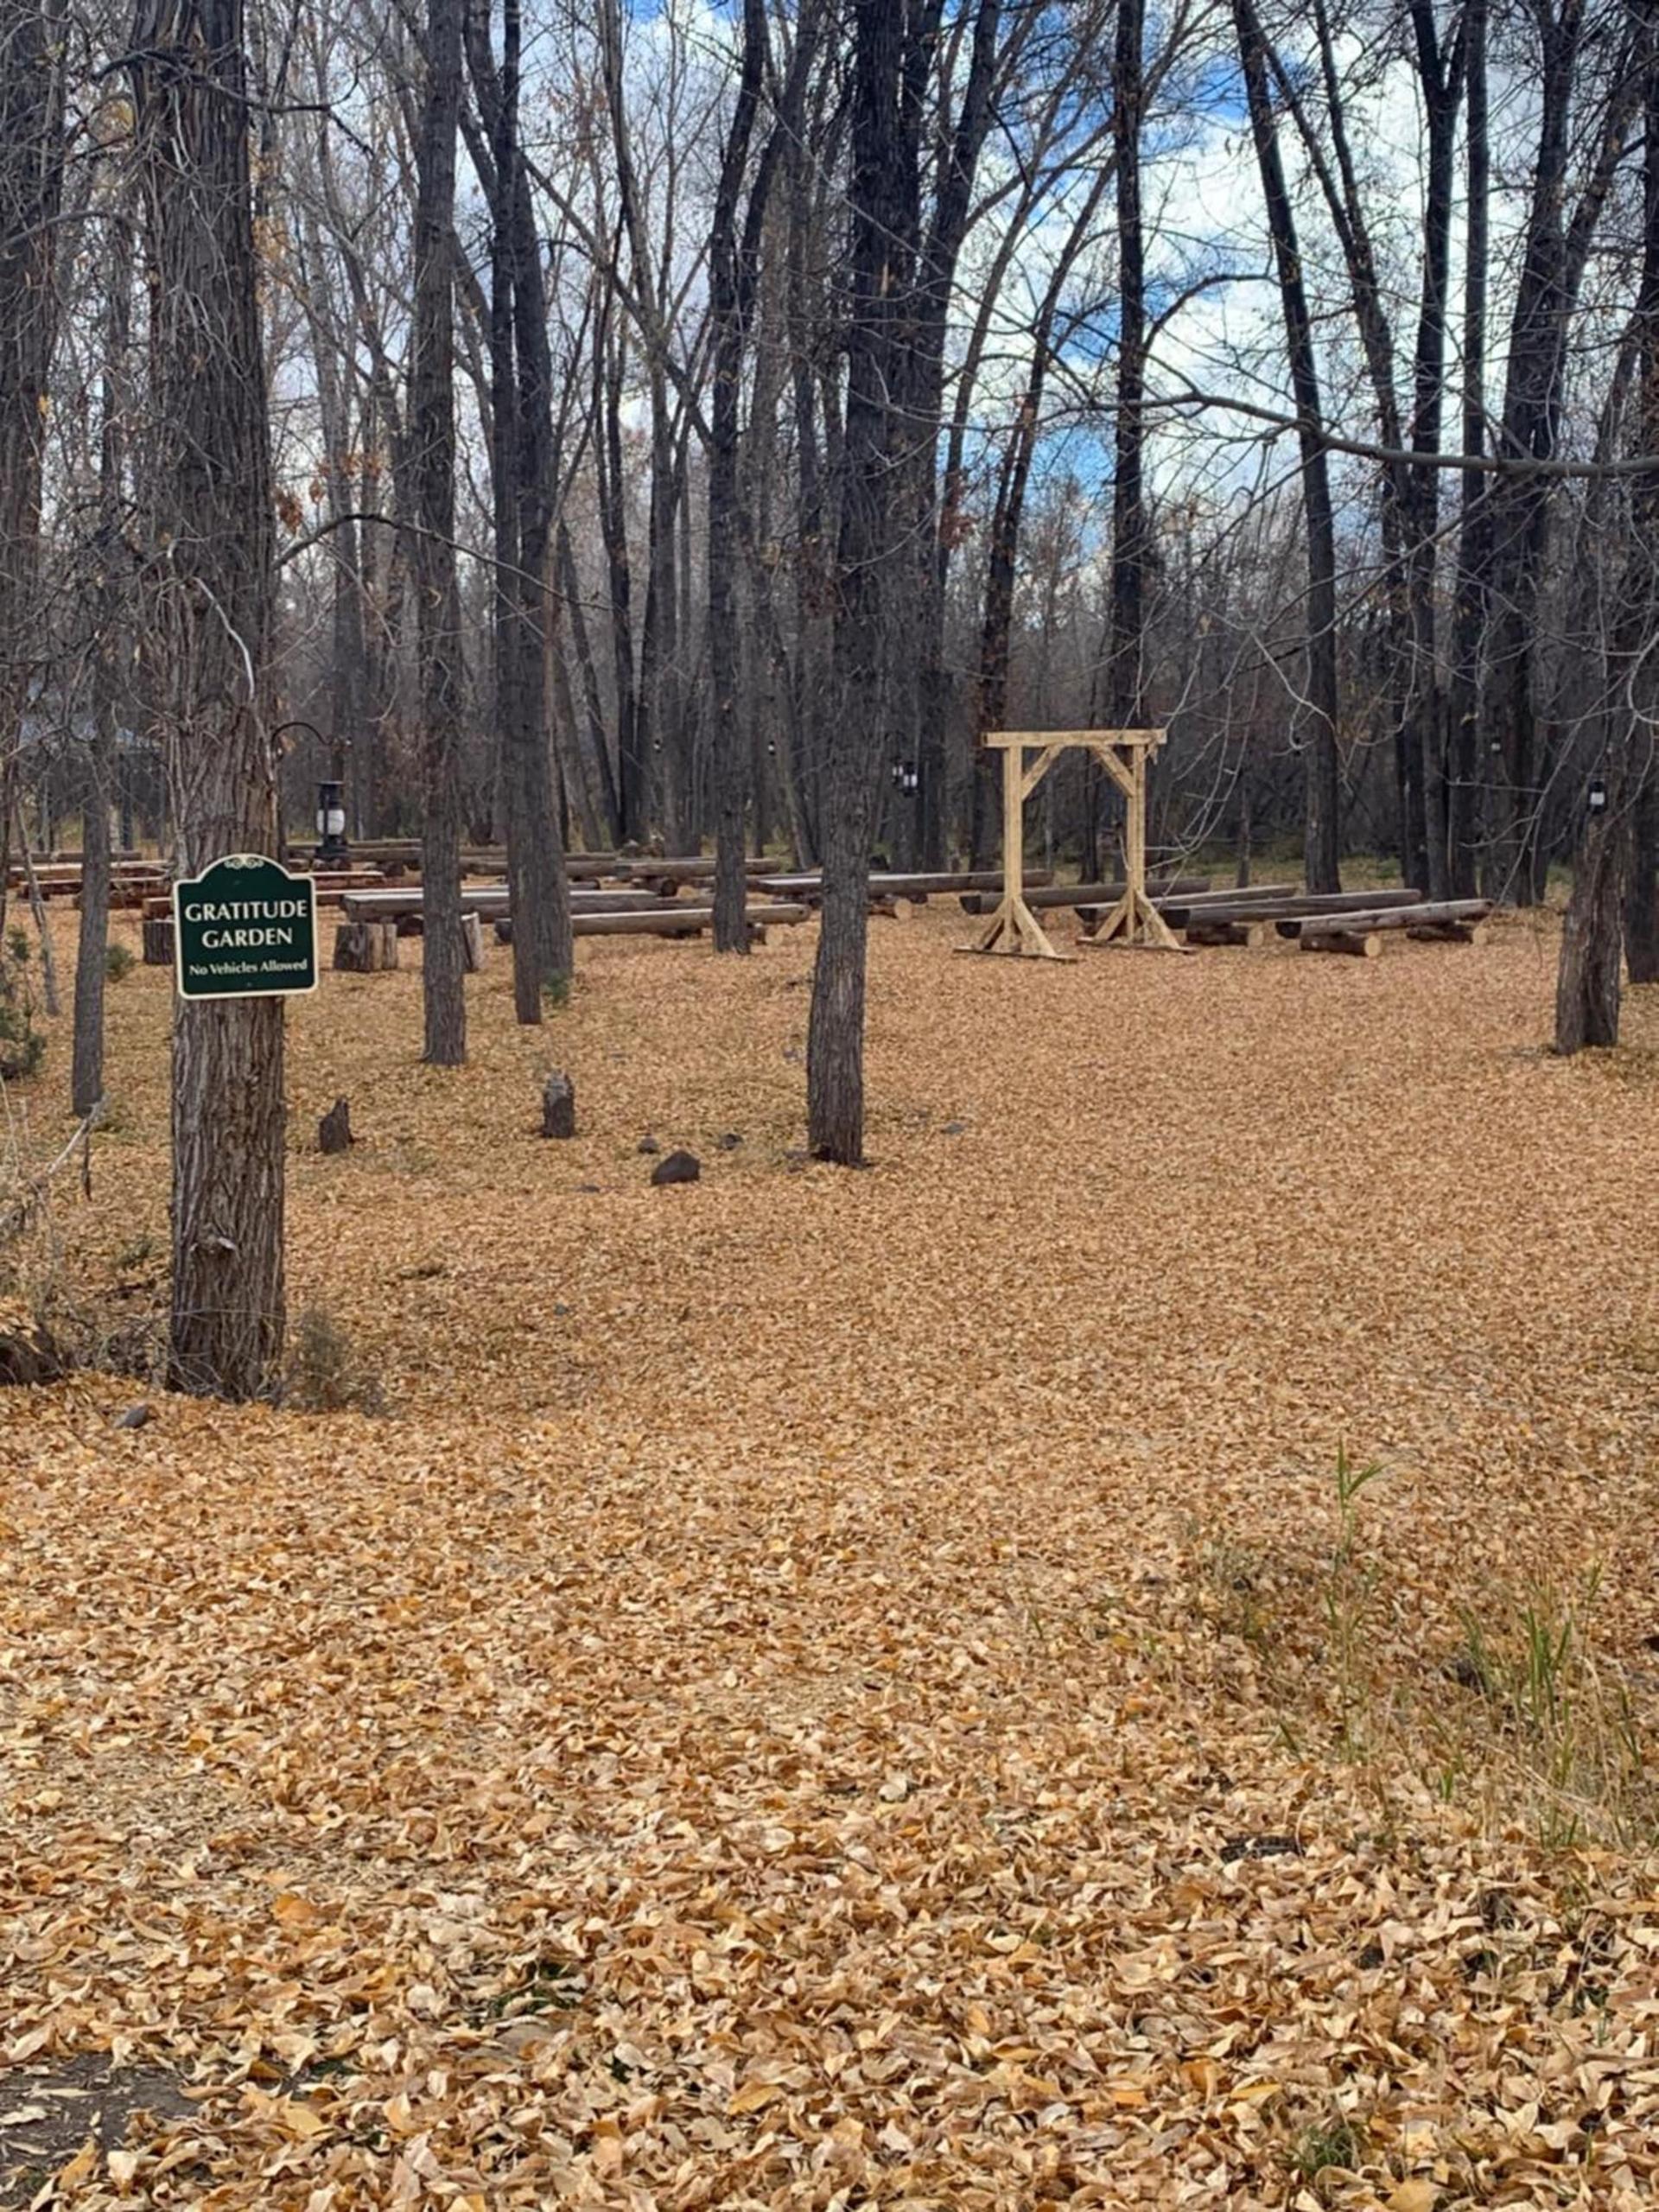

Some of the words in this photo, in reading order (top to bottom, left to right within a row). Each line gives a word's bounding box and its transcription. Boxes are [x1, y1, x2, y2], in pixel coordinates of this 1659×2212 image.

[185, 899, 308, 922] GRATITUDE
[201, 927, 293, 949] GARDEN
[189, 964, 208, 976] No
[210, 962, 257, 975] Vehicles
[260, 958, 308, 972] Allowed
